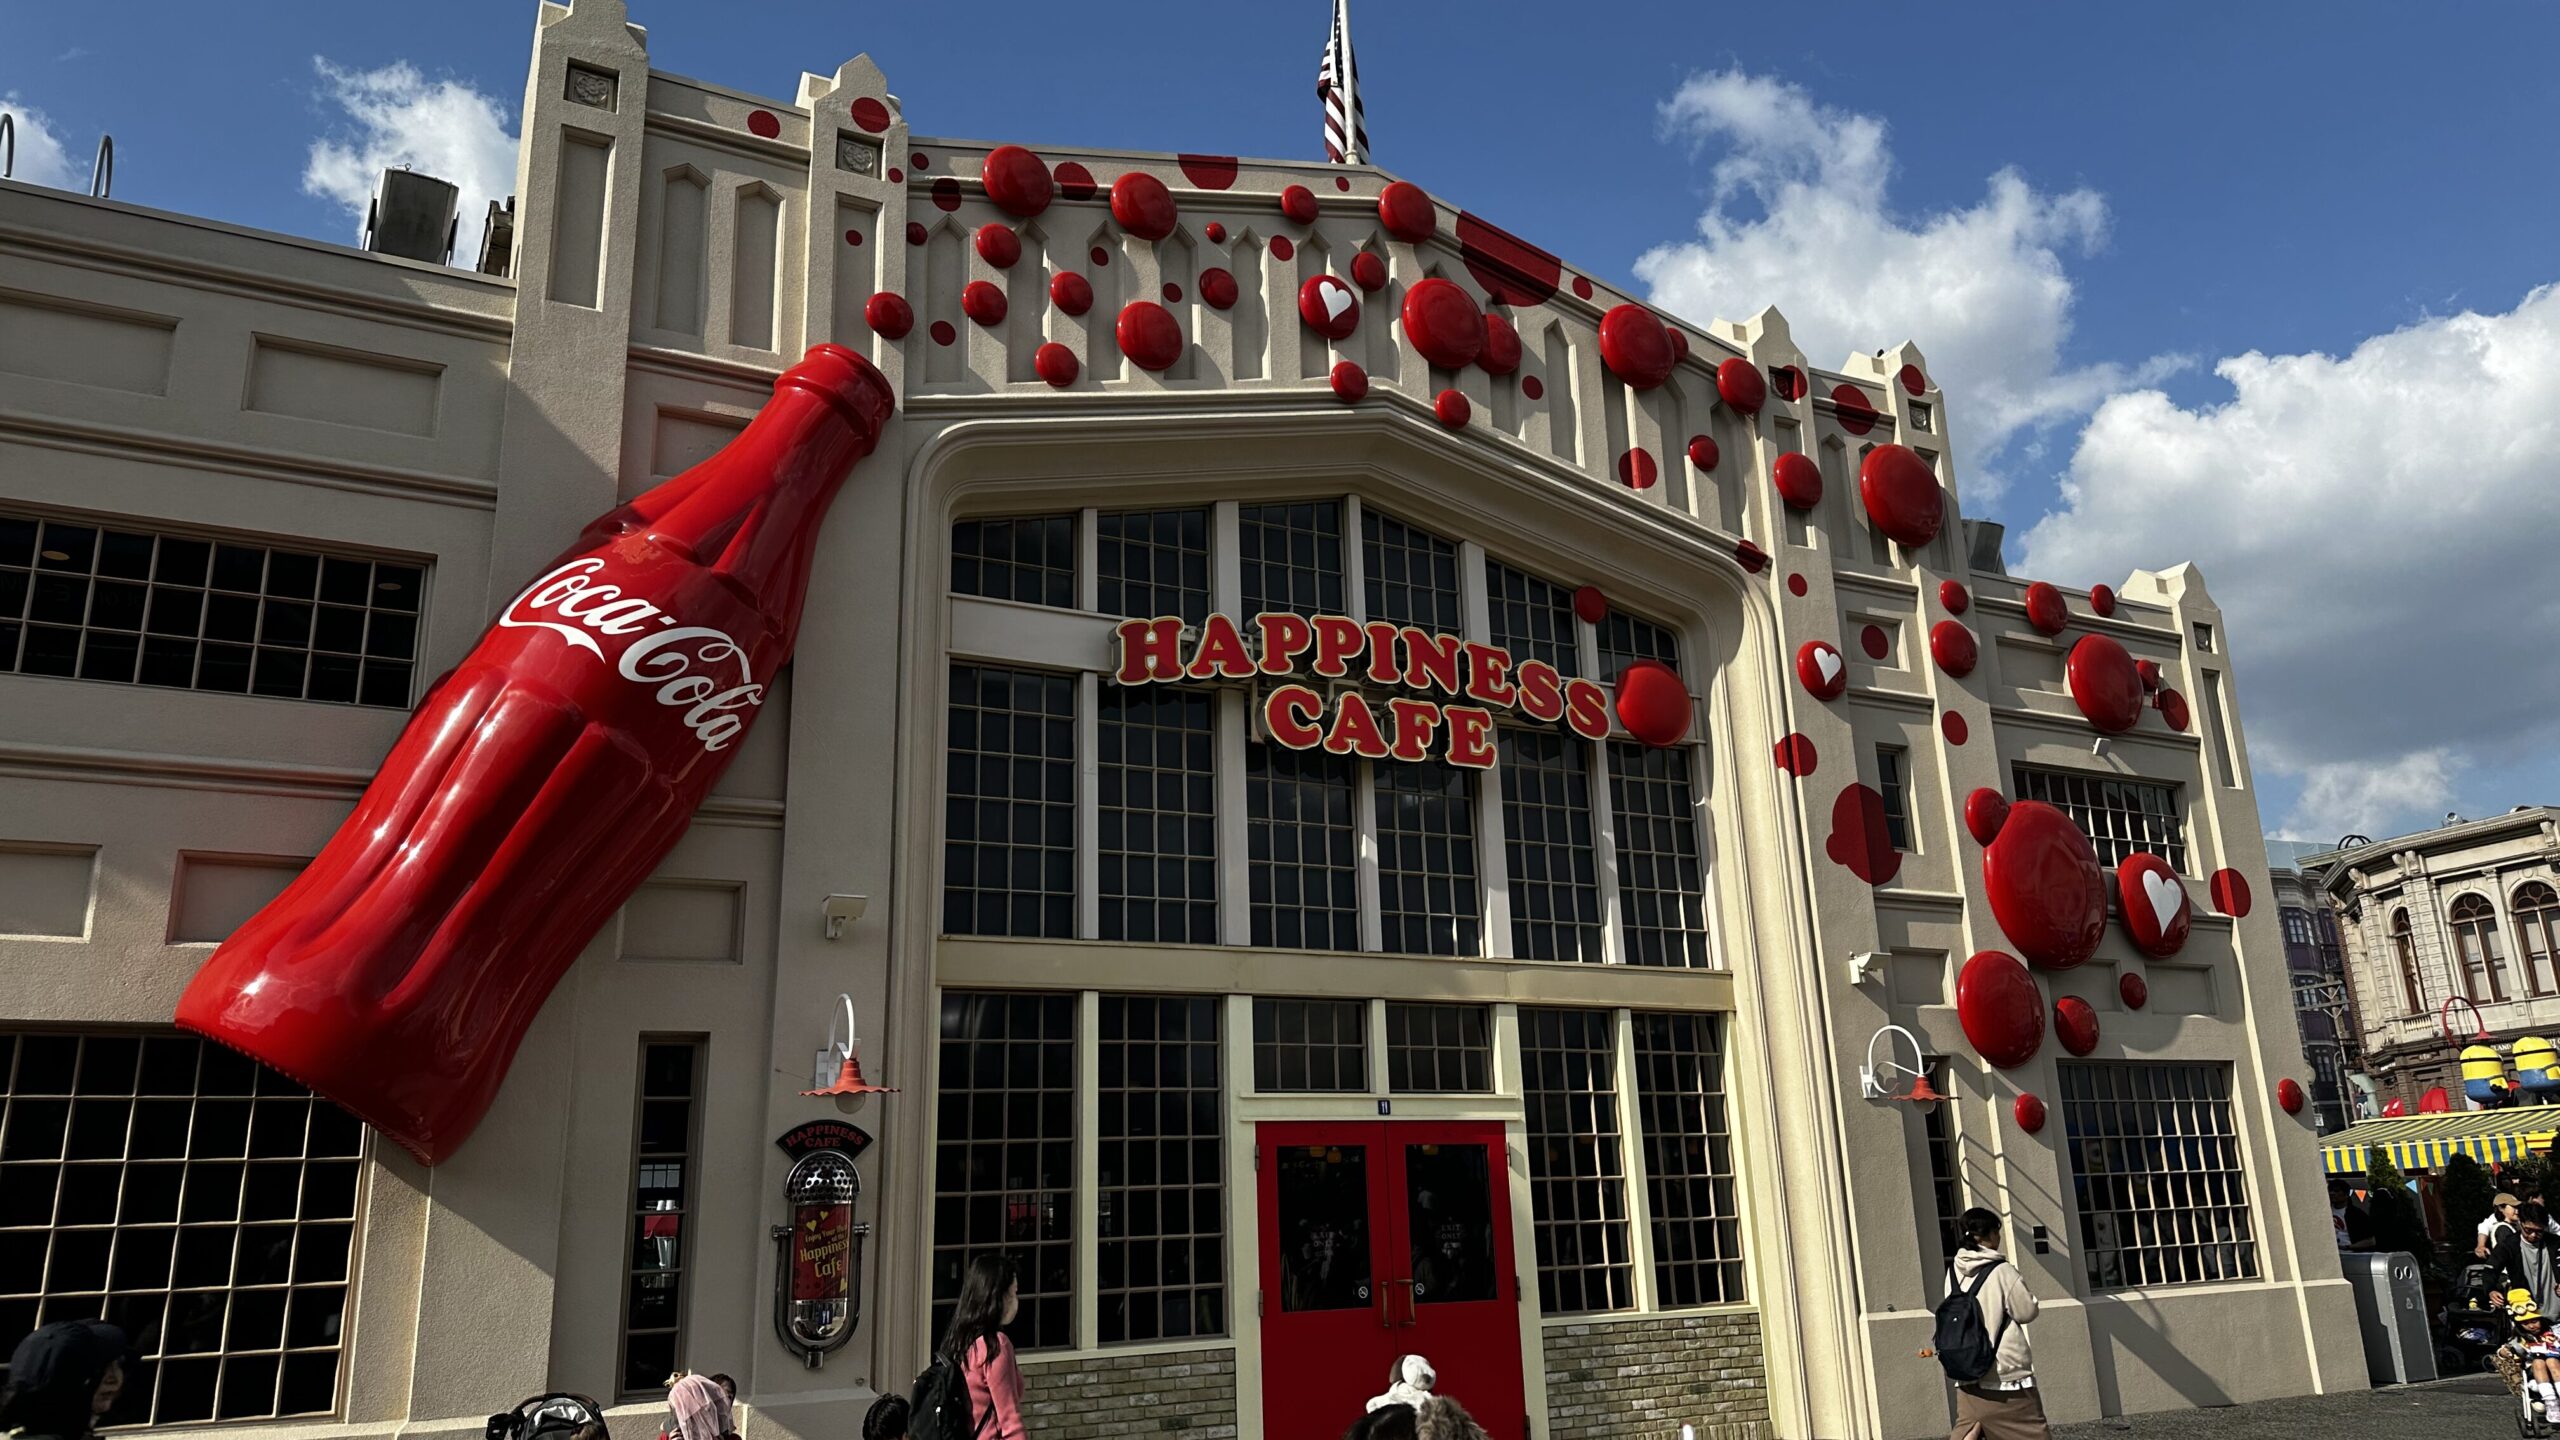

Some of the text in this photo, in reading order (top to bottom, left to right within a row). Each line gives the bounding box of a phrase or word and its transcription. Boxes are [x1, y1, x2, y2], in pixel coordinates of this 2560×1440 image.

[1115, 611, 1611, 741] HAPPINESS
[1266, 684, 1497, 770] CAFE
[785, 1125, 865, 1147] HAPPINESS
[804, 1137, 841, 1148] CAFE
